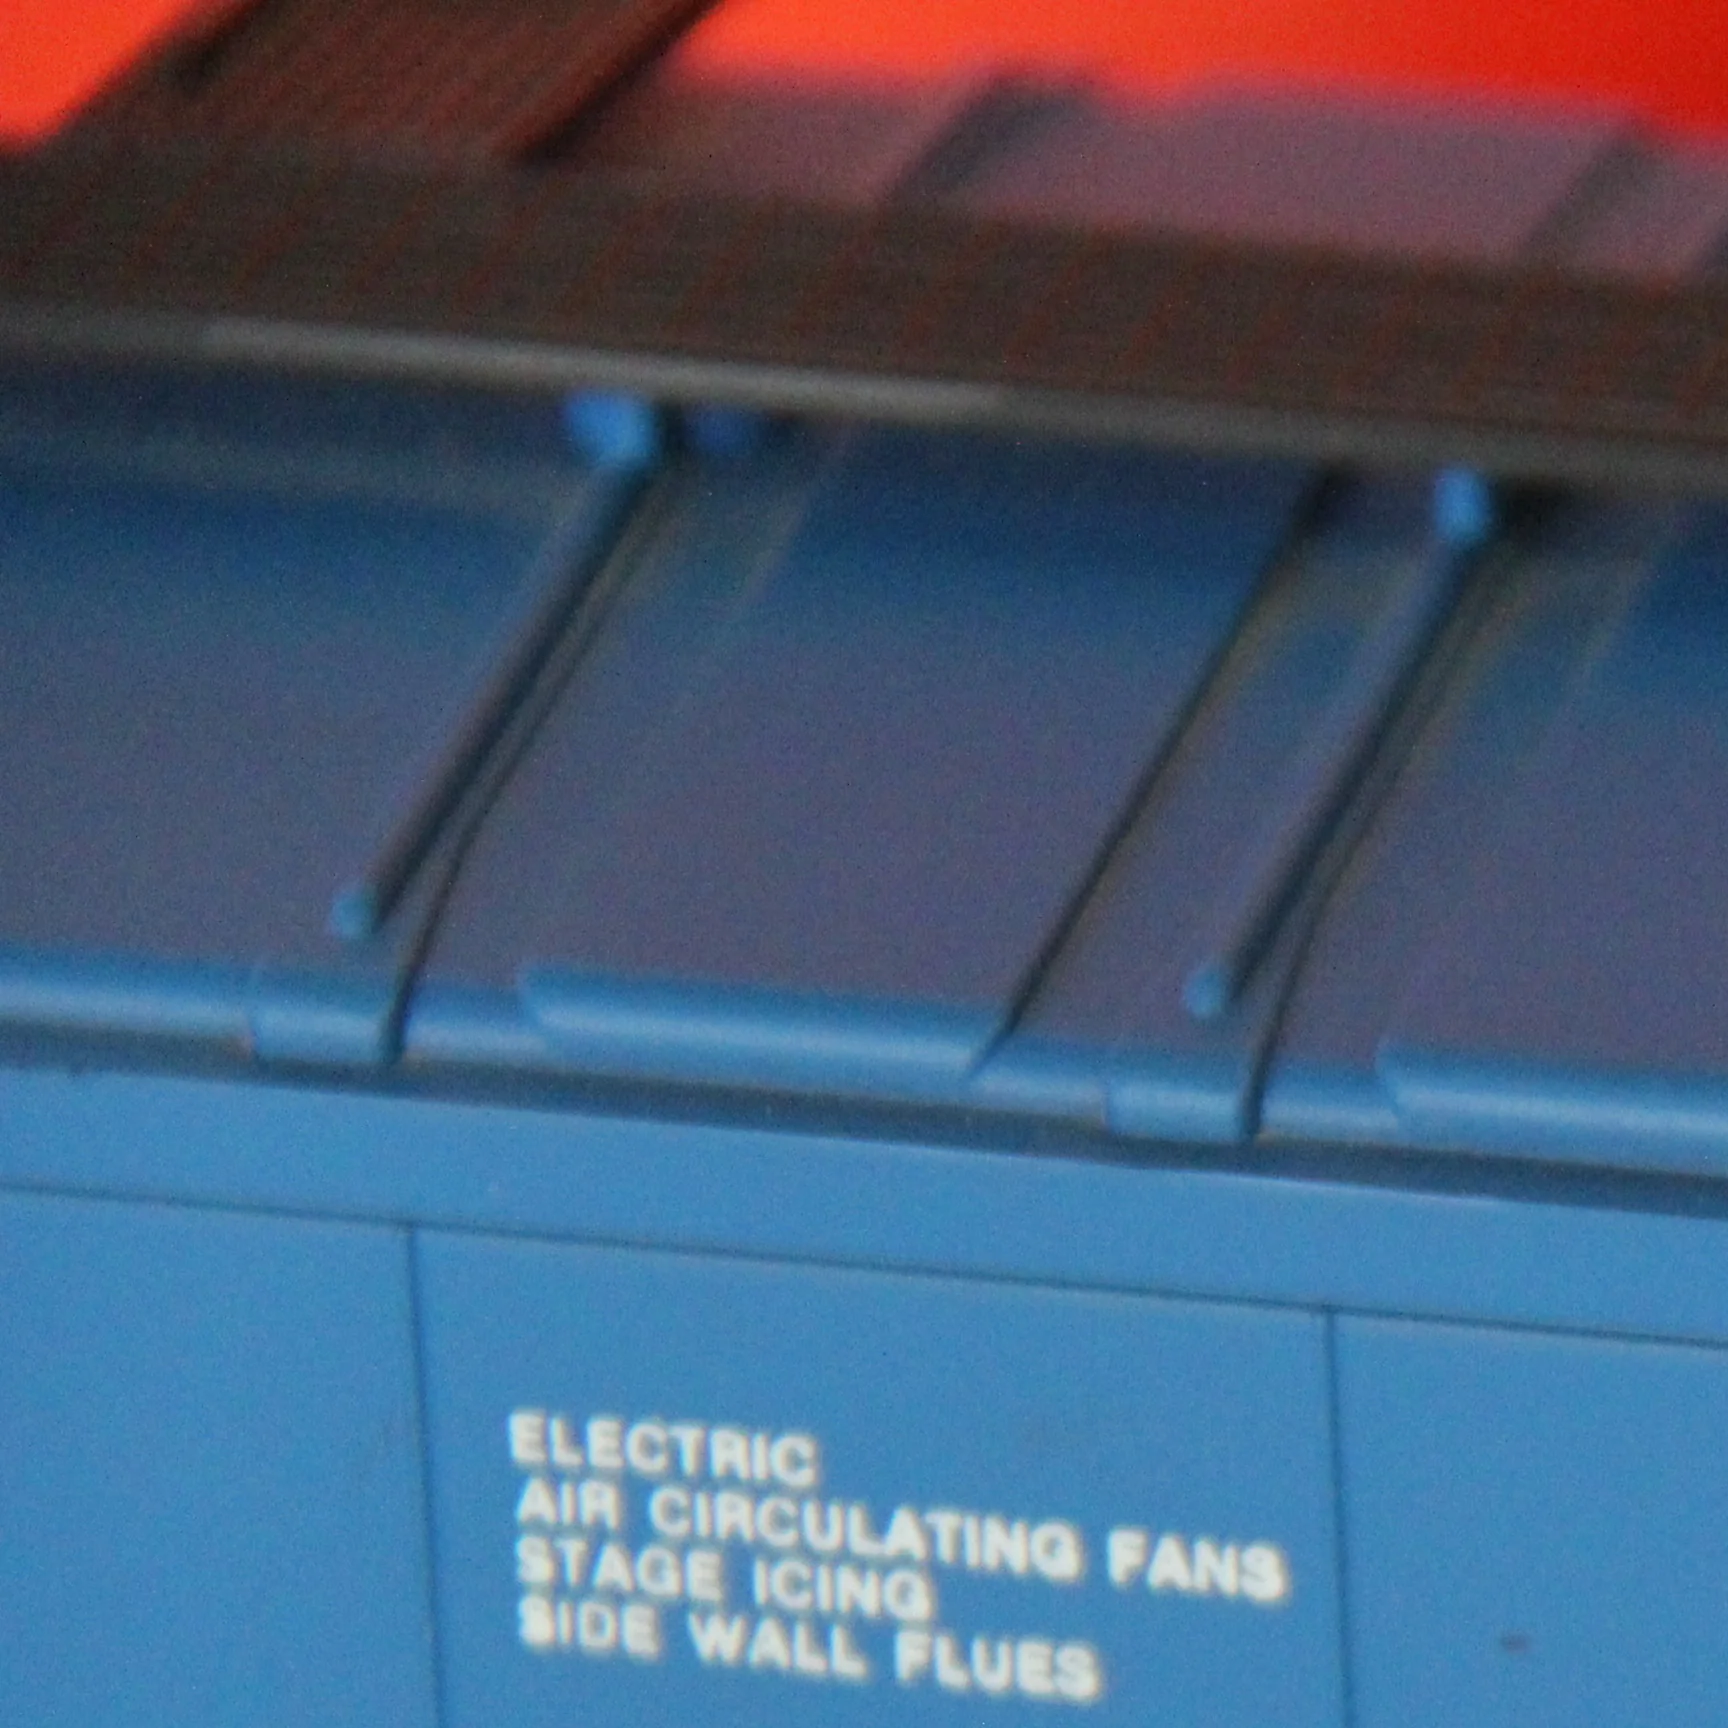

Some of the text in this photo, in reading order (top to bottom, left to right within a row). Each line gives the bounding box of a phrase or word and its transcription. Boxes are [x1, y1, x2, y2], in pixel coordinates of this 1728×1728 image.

[509, 1410, 820, 1493] ELECTRIC
[517, 1474, 1291, 1604] AIR CIRCULATING FANS
[517, 1533, 935, 1628] STAGE ICING
[519, 1593, 1104, 1703] SIDE WALL FLUES
